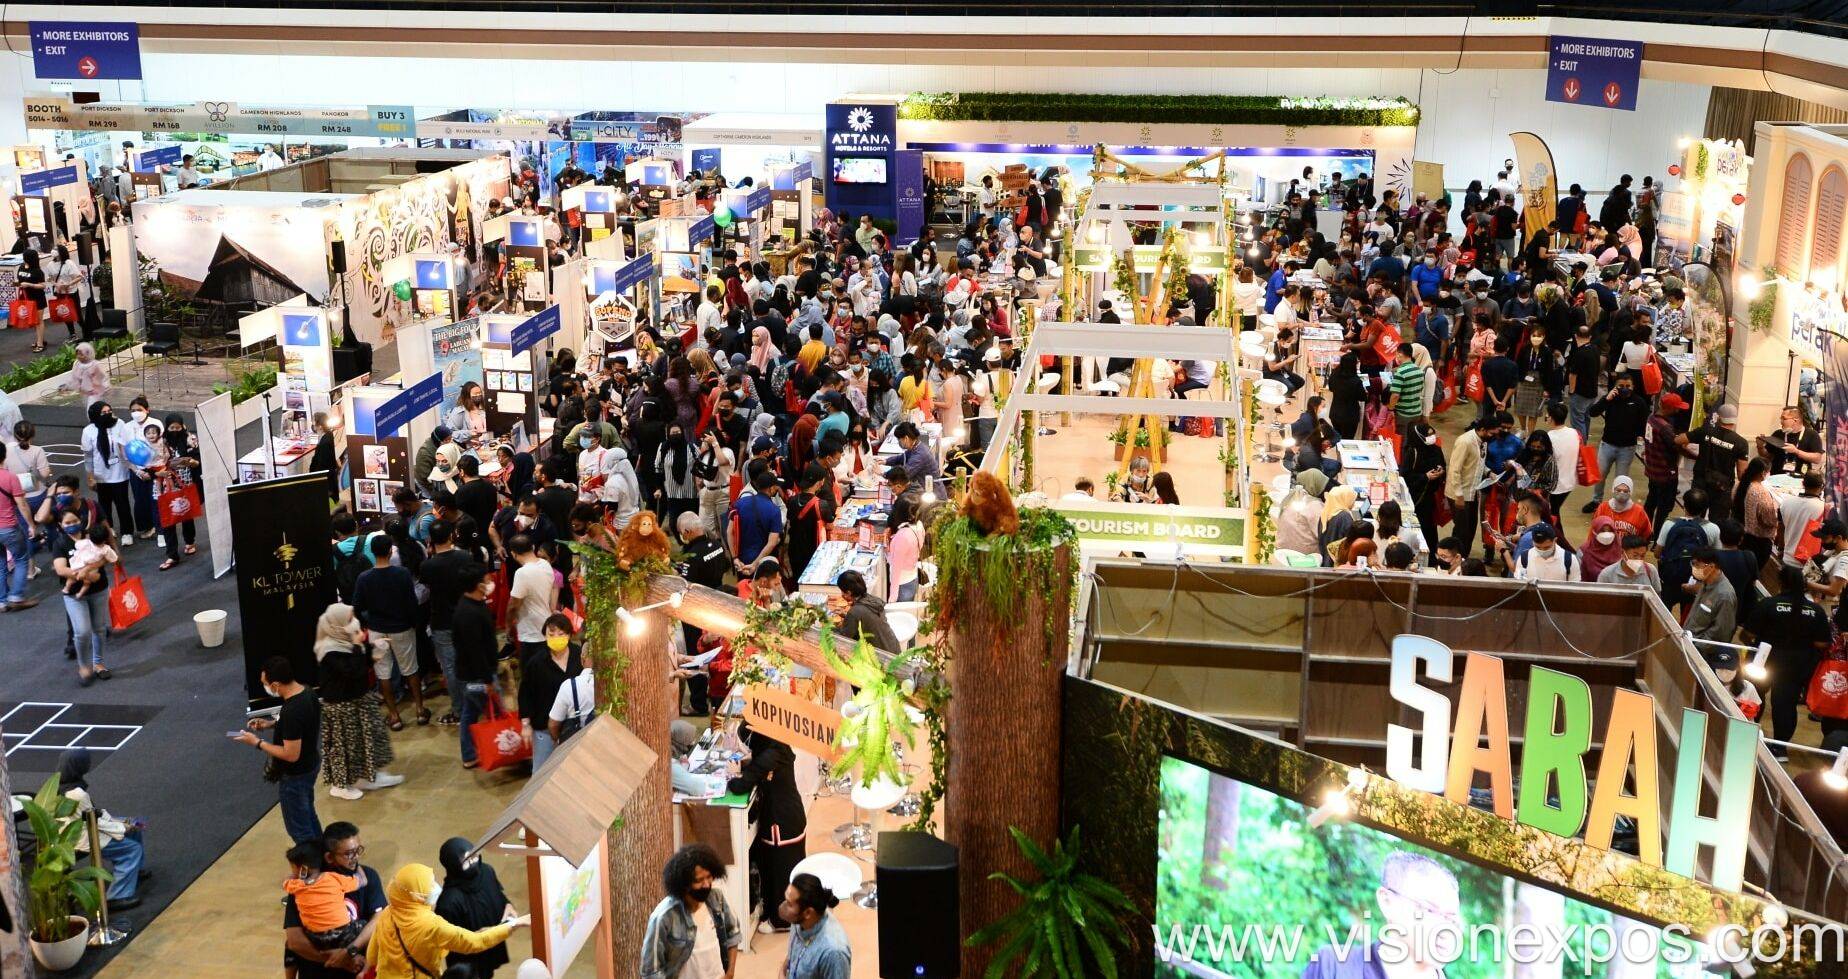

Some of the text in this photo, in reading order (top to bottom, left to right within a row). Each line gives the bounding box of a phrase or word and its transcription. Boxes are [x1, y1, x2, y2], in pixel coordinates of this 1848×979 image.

[43, 31, 130, 41] MORE EXHIBITORS
[45, 46, 67, 55] EXIT
[1560, 43, 1635, 59] MORE EXHIBITORS
[1559, 60, 1578, 71] EXIT
[27, 105, 62, 113] BOOTH
[377, 111, 405, 120] BUY 3
[88, 120, 102, 128] RM
[257, 124, 272, 132] RM
[322, 125, 336, 133] RM
[597, 125, 632, 137] I-CITY
[831, 133, 891, 144] ATTANA
[595, 306, 632, 317] GOPENG
[448, 328, 460, 338] BIG
[1066, 517, 1221, 539] TOURISM BOARD
[252, 566, 322, 588] KL TOWER
[752, 697, 835, 746] KOPIVOSIAN
[1386, 633, 1761, 894] SABAH
